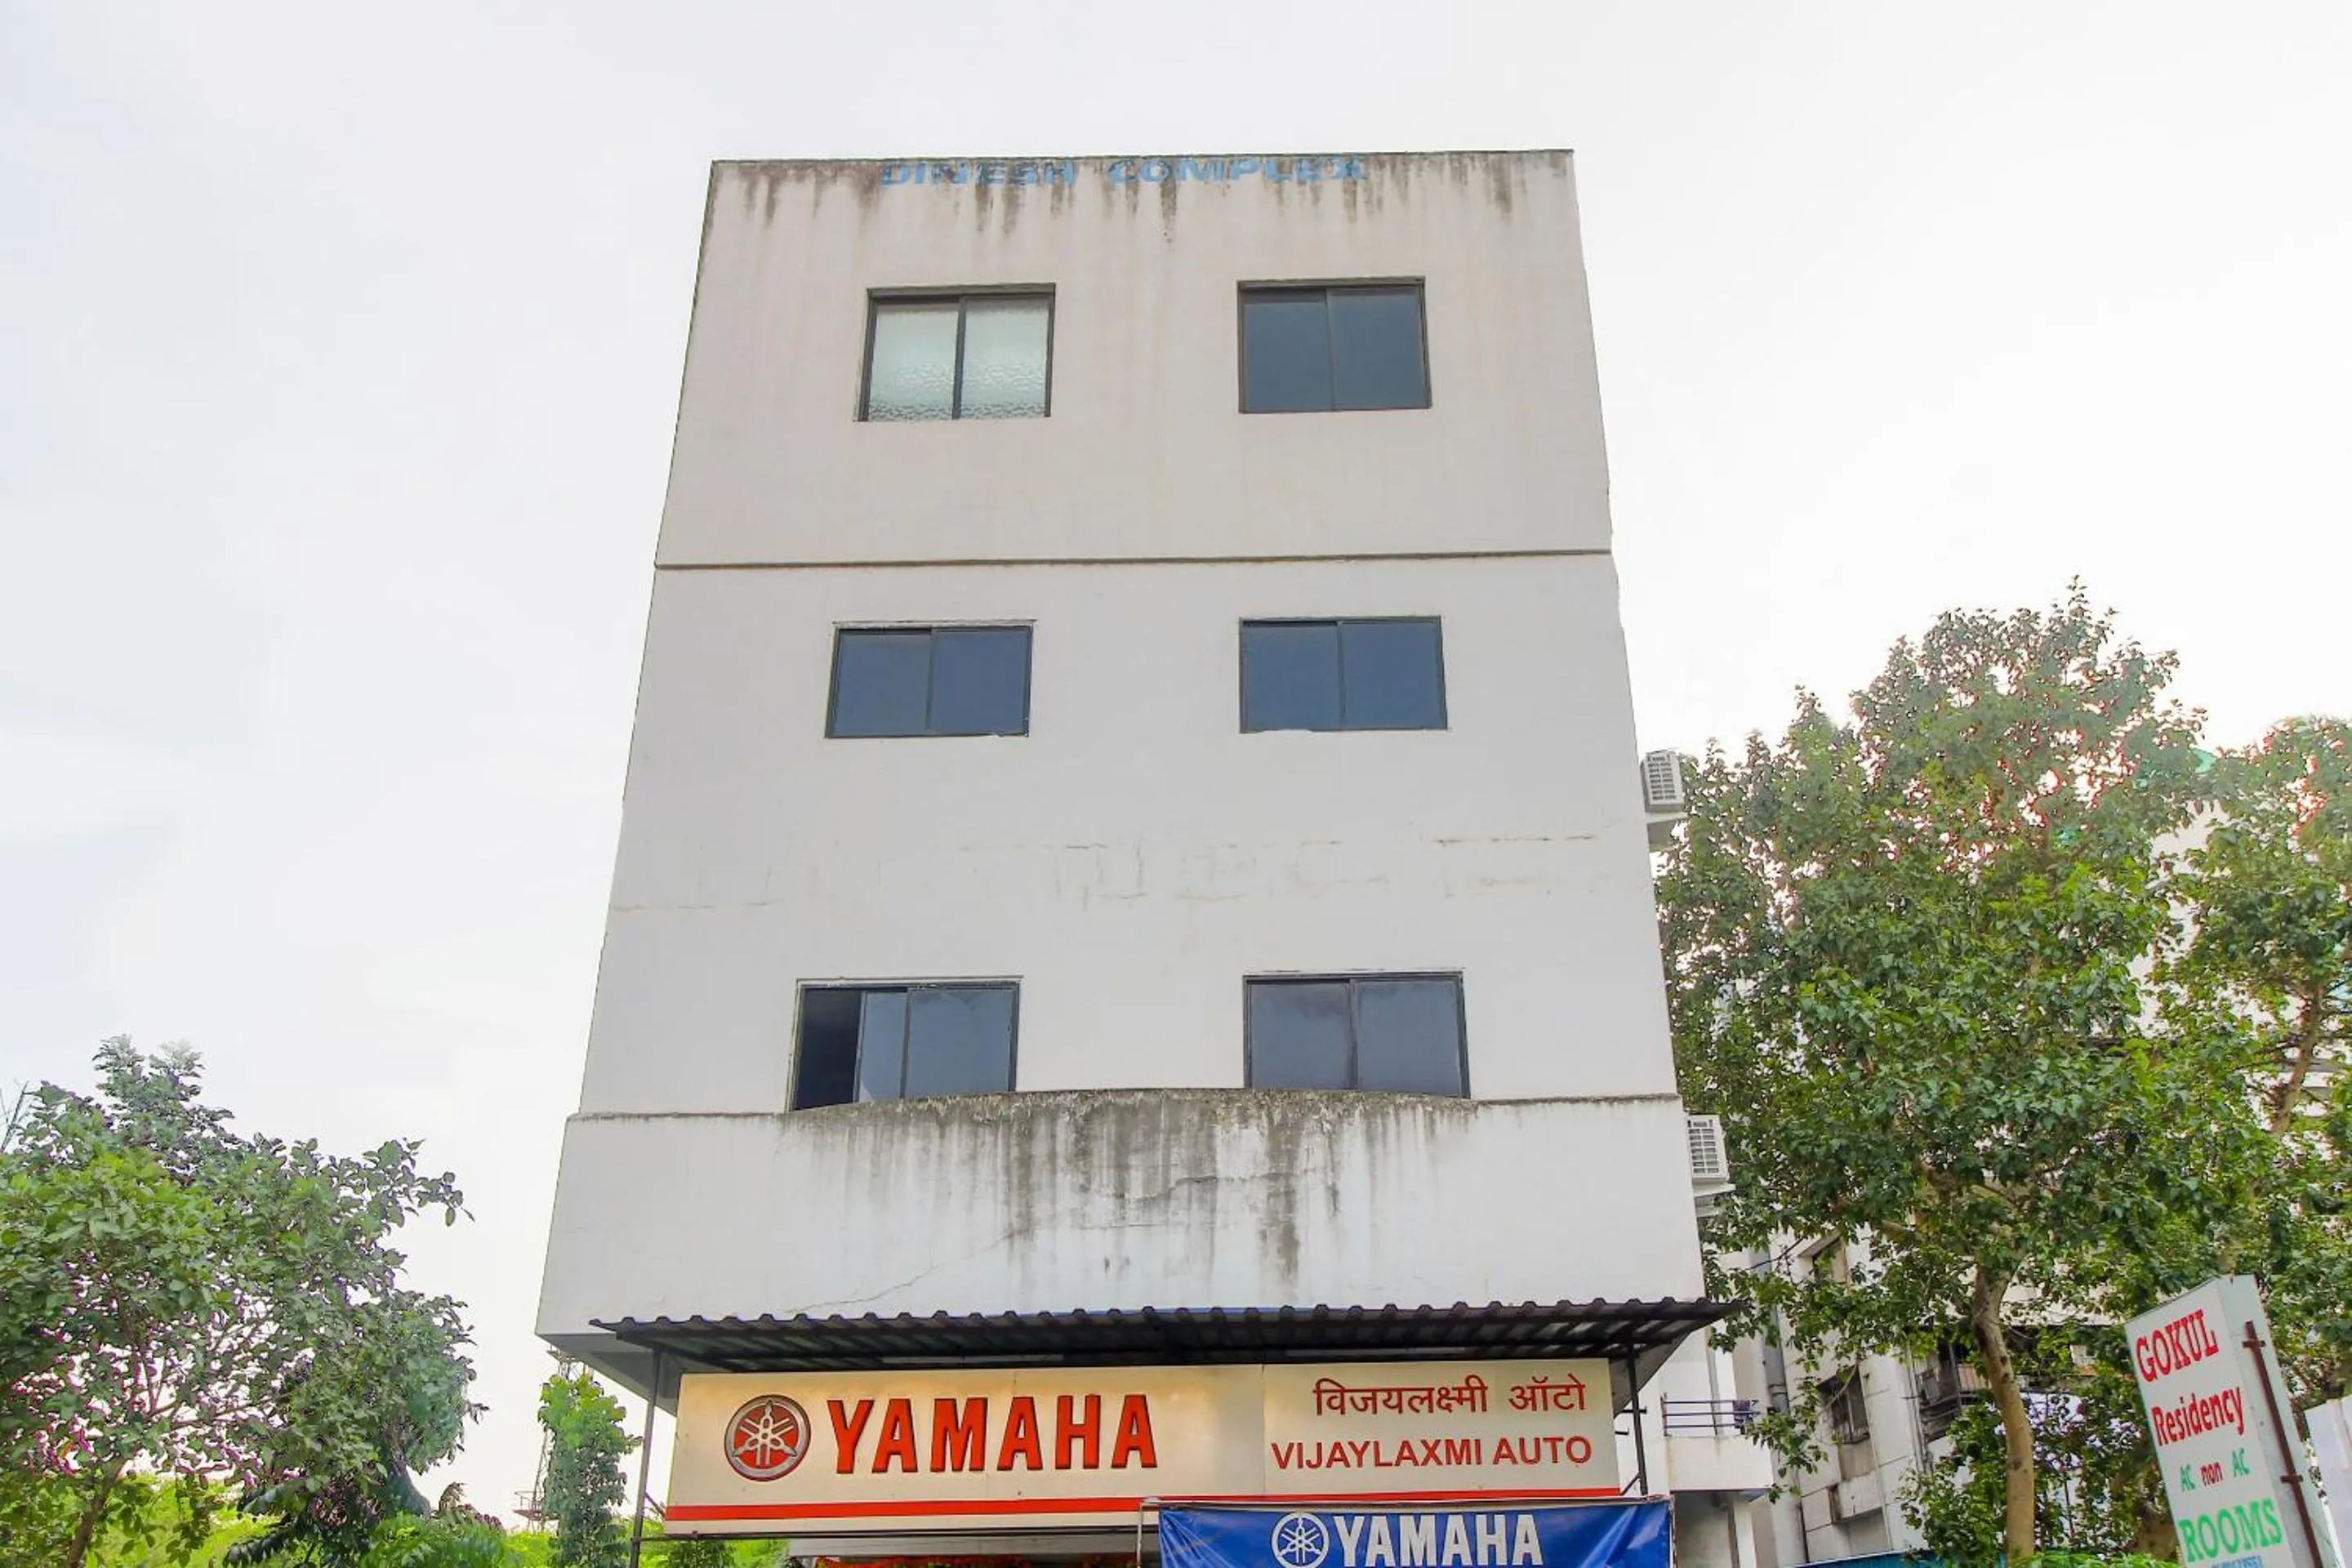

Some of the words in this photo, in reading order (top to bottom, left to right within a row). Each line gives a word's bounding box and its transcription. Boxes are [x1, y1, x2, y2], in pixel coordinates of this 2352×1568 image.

[880, 161, 1076, 185] DINESH
[1107, 158, 1365, 182] COMPLEX
[2136, 1309, 2219, 1382] GOKUL
[1313, 1375, 1487, 1415] विजयलक्ष्मी
[1508, 1373, 1587, 1411] ऑटो
[2150, 1387, 2244, 1446] Residency
[827, 1394, 1157, 1473] YAMAHA
[1271, 1438, 1483, 1469] VIJAYLAXMI
[1493, 1436, 1592, 1466] AUTO
[2200, 1462, 2224, 1487] non
[2232, 1448, 2250, 1478] AC
[1334, 1513, 1543, 1567] YAMAHA
[2178, 1498, 2283, 1562] ROOMS
